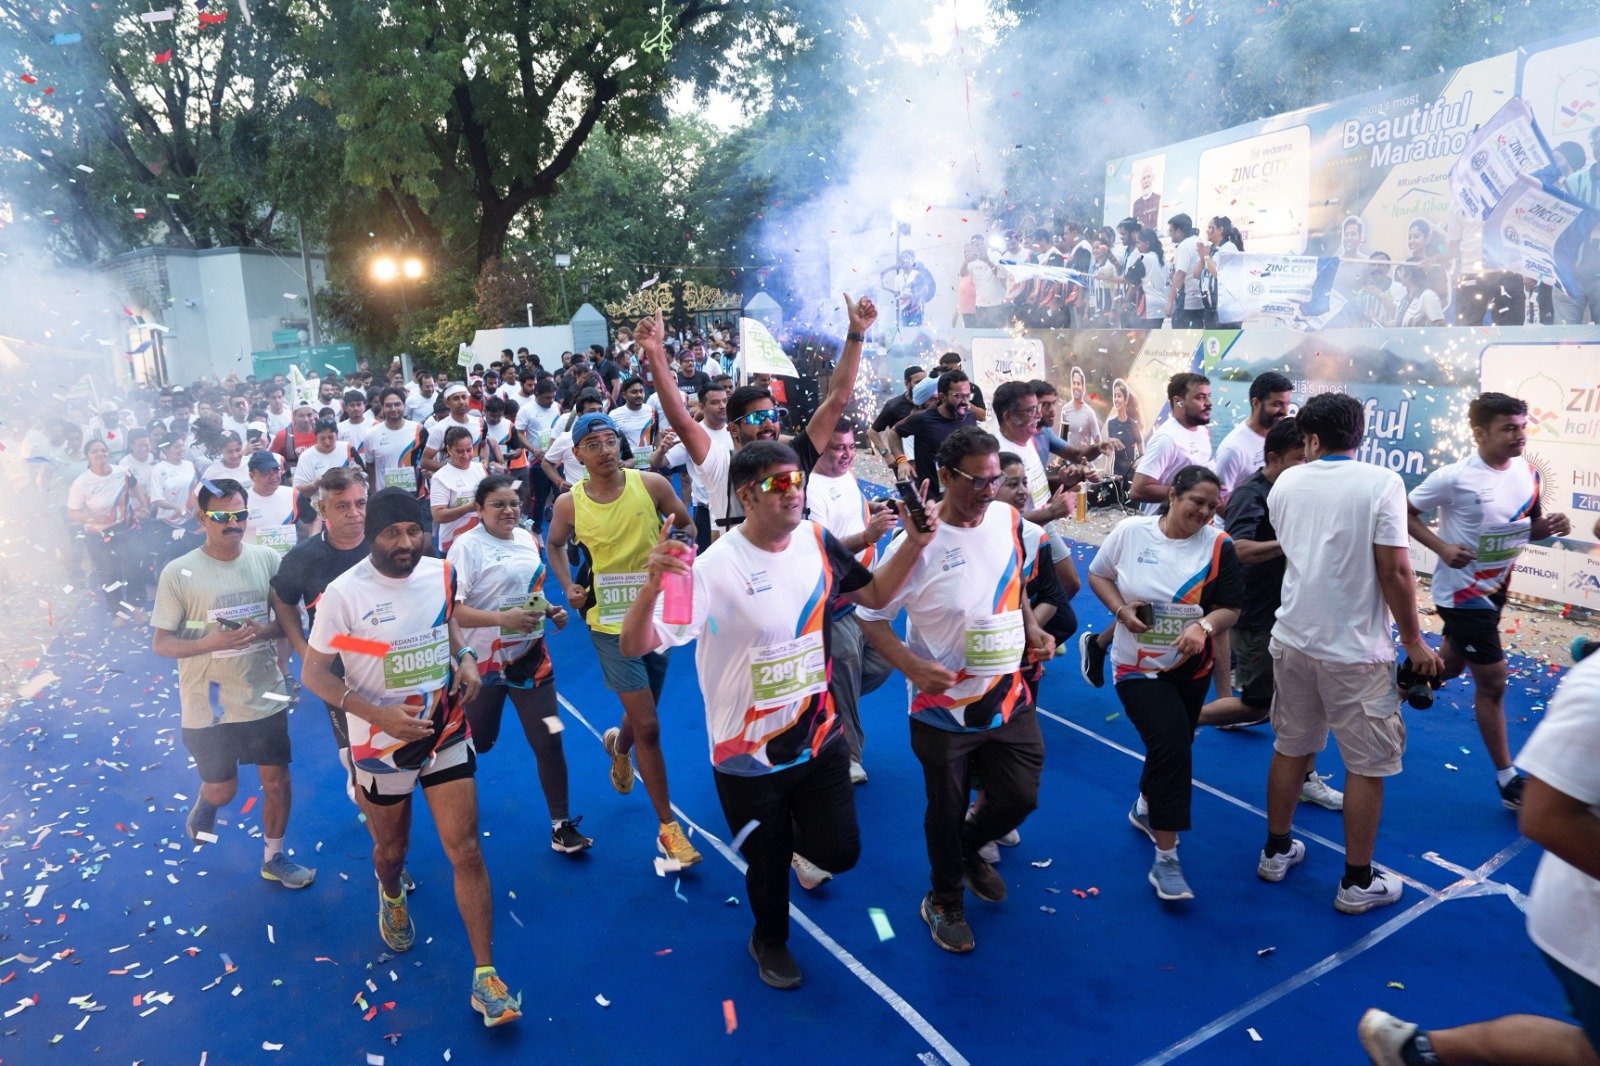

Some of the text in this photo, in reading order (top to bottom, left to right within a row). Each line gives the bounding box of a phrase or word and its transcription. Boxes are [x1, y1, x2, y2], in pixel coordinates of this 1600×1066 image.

[1359, 93, 1420, 117] India's most
[1342, 90, 1473, 150] Beautiful
[1262, 142, 1293, 156] vedanta
[1231, 158, 1290, 183] ZINC CITY
[1265, 264, 1290, 273] ZINC
[1292, 380, 1315, 394] dia's
[1523, 547, 1550, 557] Partner:
[602, 574, 624, 582] VEDANTA
[1512, 563, 1559, 580] ECATHLON
[603, 587, 638, 604] 3018
[391, 636, 418, 646] VEDANTA
[419, 632, 431, 641] ZINC
[391, 648, 435, 674] 3089
[760, 655, 807, 686] 2897
